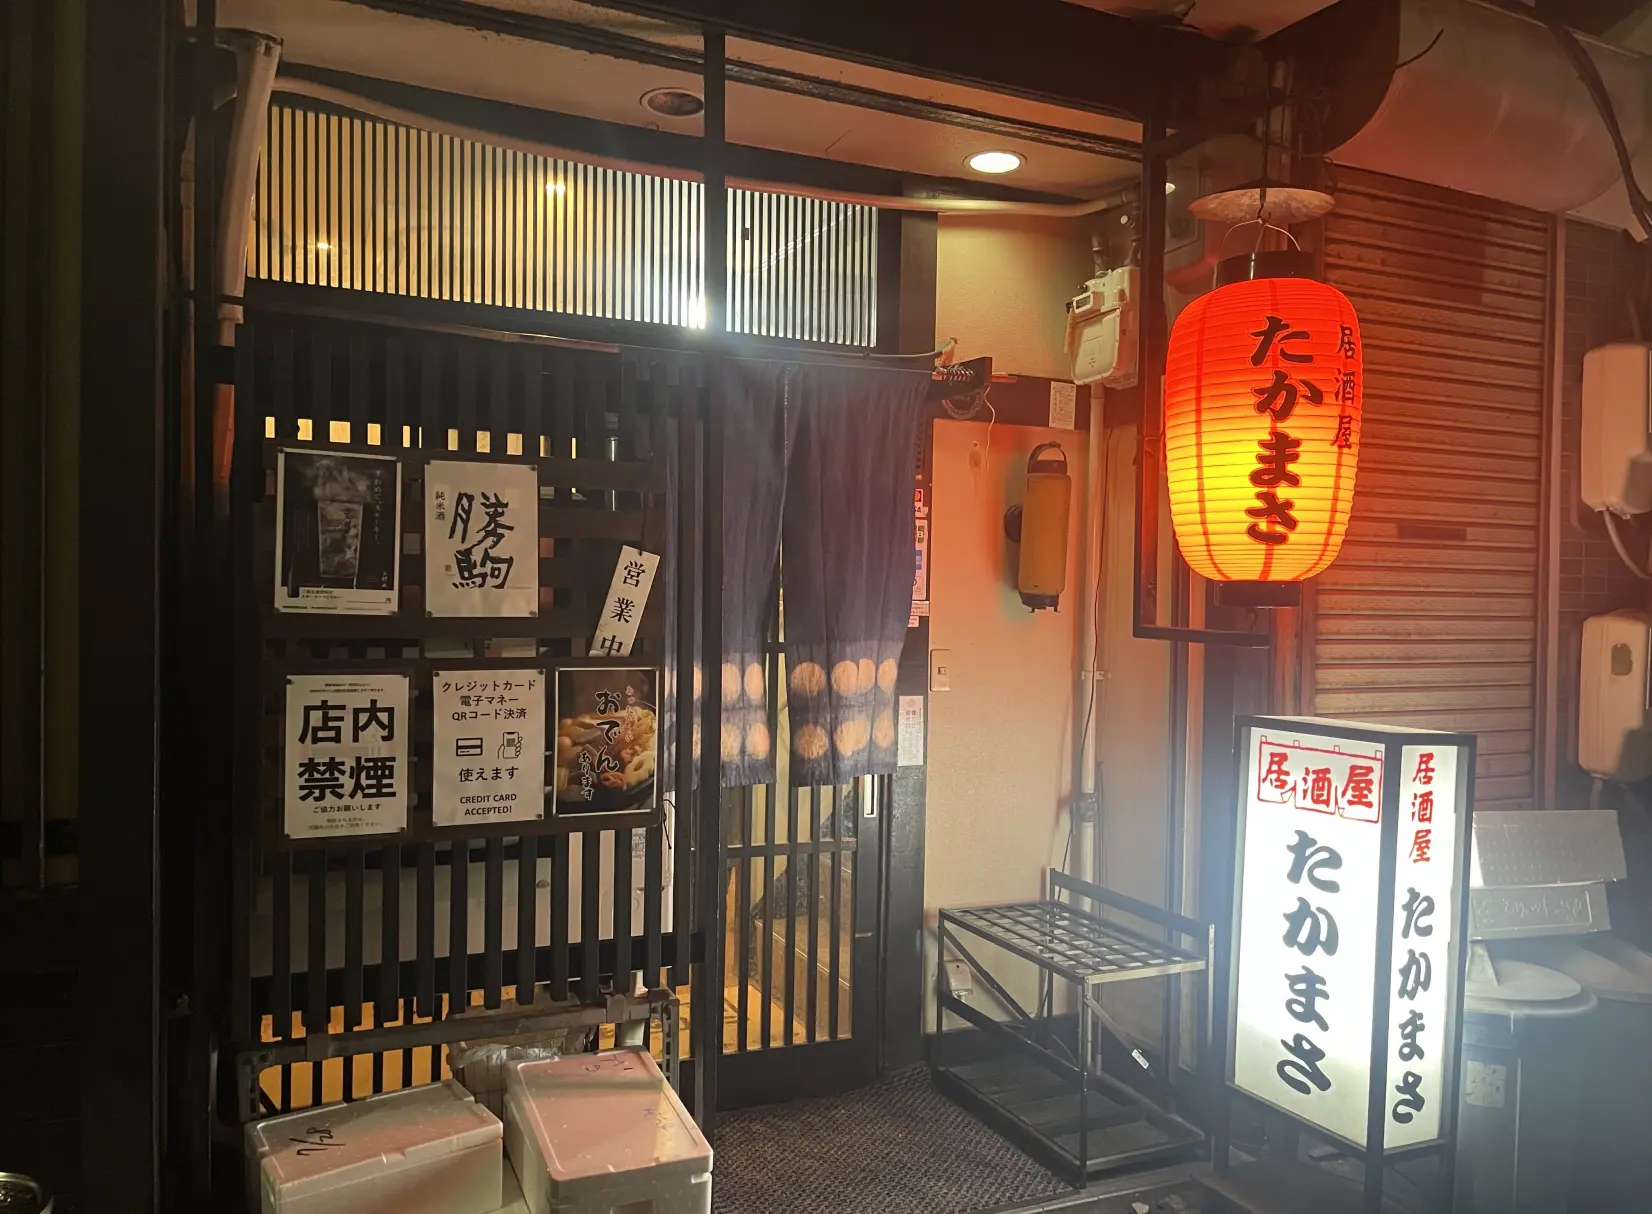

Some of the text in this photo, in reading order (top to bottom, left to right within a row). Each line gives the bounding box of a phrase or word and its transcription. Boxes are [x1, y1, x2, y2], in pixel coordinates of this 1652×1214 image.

[1331, 324, 1357, 450] 居酒屋
[1245, 315, 1324, 545] たかまさ
[434, 489, 447, 522] 純米酒
[600, 559, 647, 657] 営業中
[442, 680, 537, 693] クレジットカード
[460, 695, 519, 707] 電子マネー
[298, 699, 395, 744] 店内
[452, 708, 528, 722] QRコード決済
[595, 690, 622, 773] おでん
[297, 756, 397, 802] 禁煙
[459, 765, 519, 783] 使えます
[578, 750, 595, 801] あります
[1262, 752, 1375, 809] 居酒屋
[312, 803, 381, 814] ご協力お願いします
[459, 793, 517, 804] CREDIT CARD
[464, 807, 512, 816] ACCEPTED!
[1409, 752, 1436, 864] 居酒屋
[1276, 829, 1343, 1096] たかまさ
[1391, 886, 1436, 1125] たかまさ
